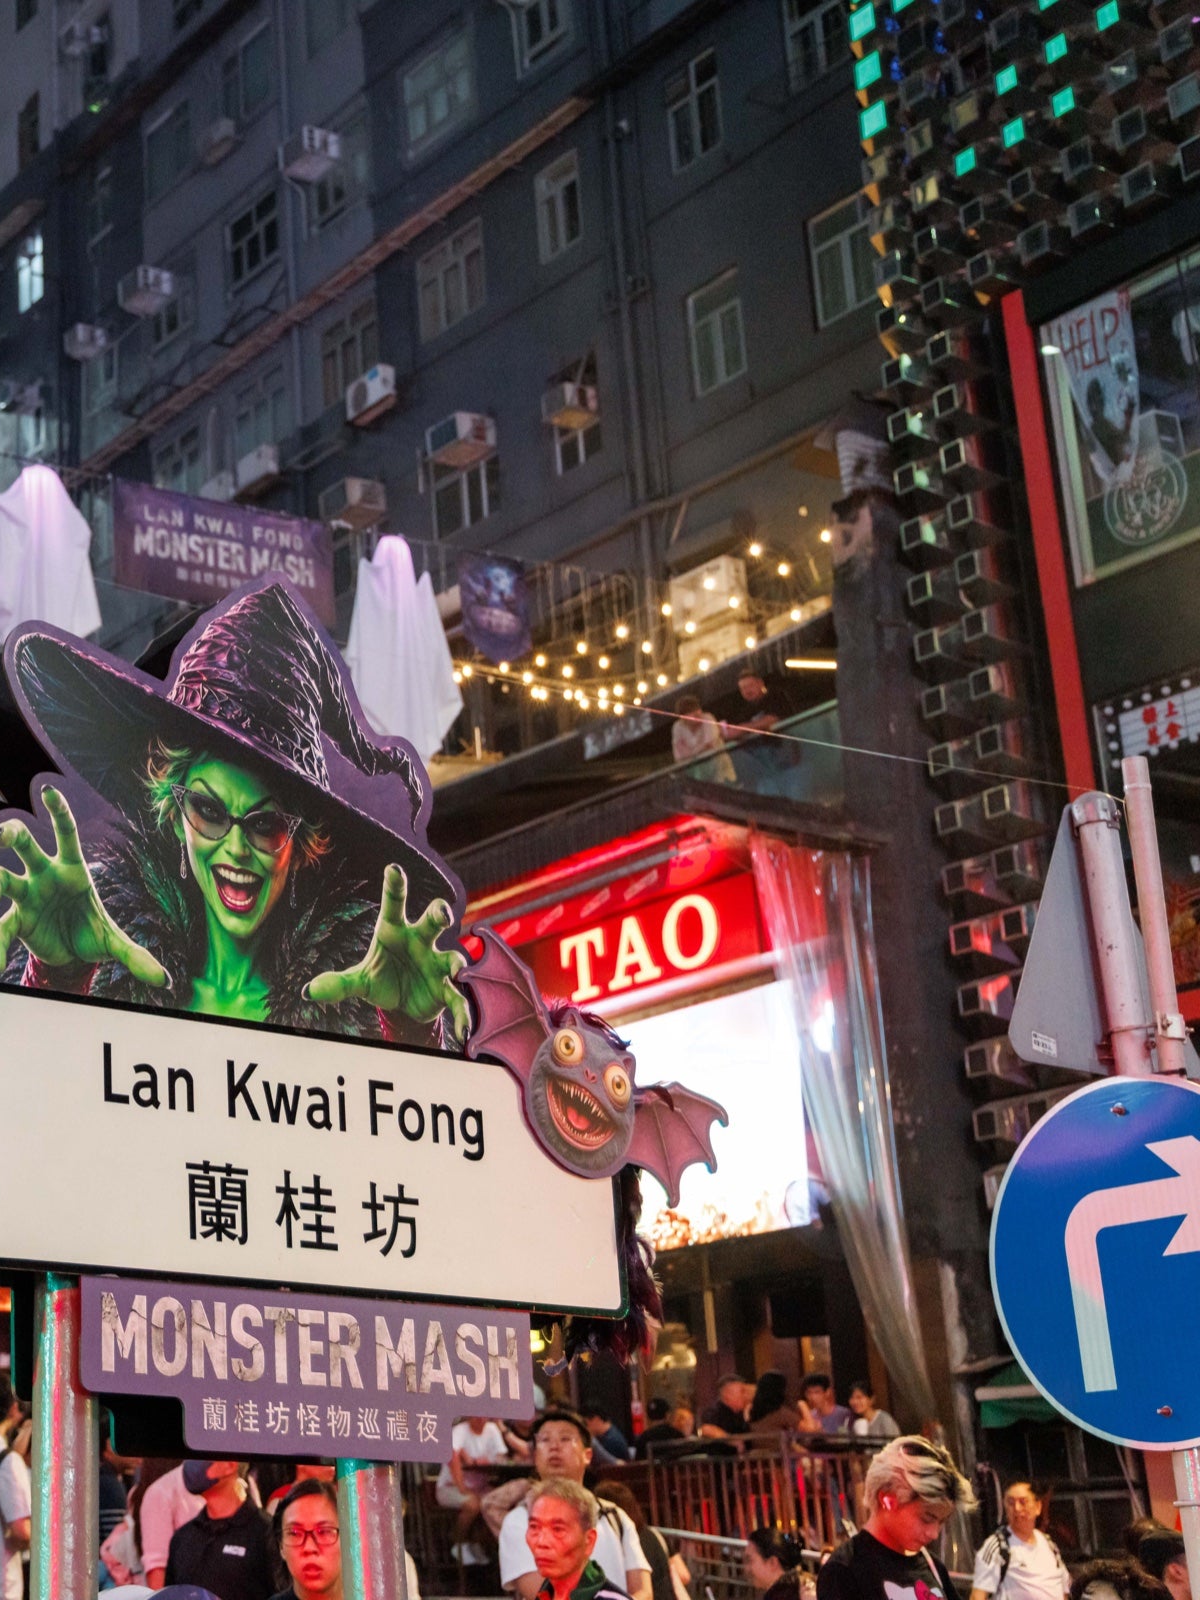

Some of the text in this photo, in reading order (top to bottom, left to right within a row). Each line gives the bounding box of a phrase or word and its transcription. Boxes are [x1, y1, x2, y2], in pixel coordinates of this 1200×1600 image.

[1057, 305, 1120, 372] HELP
[133, 523, 247, 575] MONSTER
[251, 547, 315, 588] MASH
[143, 504, 304, 551] LAN KWAI FONG
[559, 893, 719, 1003] TAO
[102, 1041, 486, 1162] Lan Kwai Fong
[185, 1159, 420, 1259] 蘭桂坊
[100, 1291, 521, 1401] MONSTER MASH
[201, 1396, 440, 1444] 蘭桂坊怪物巡禮夜
